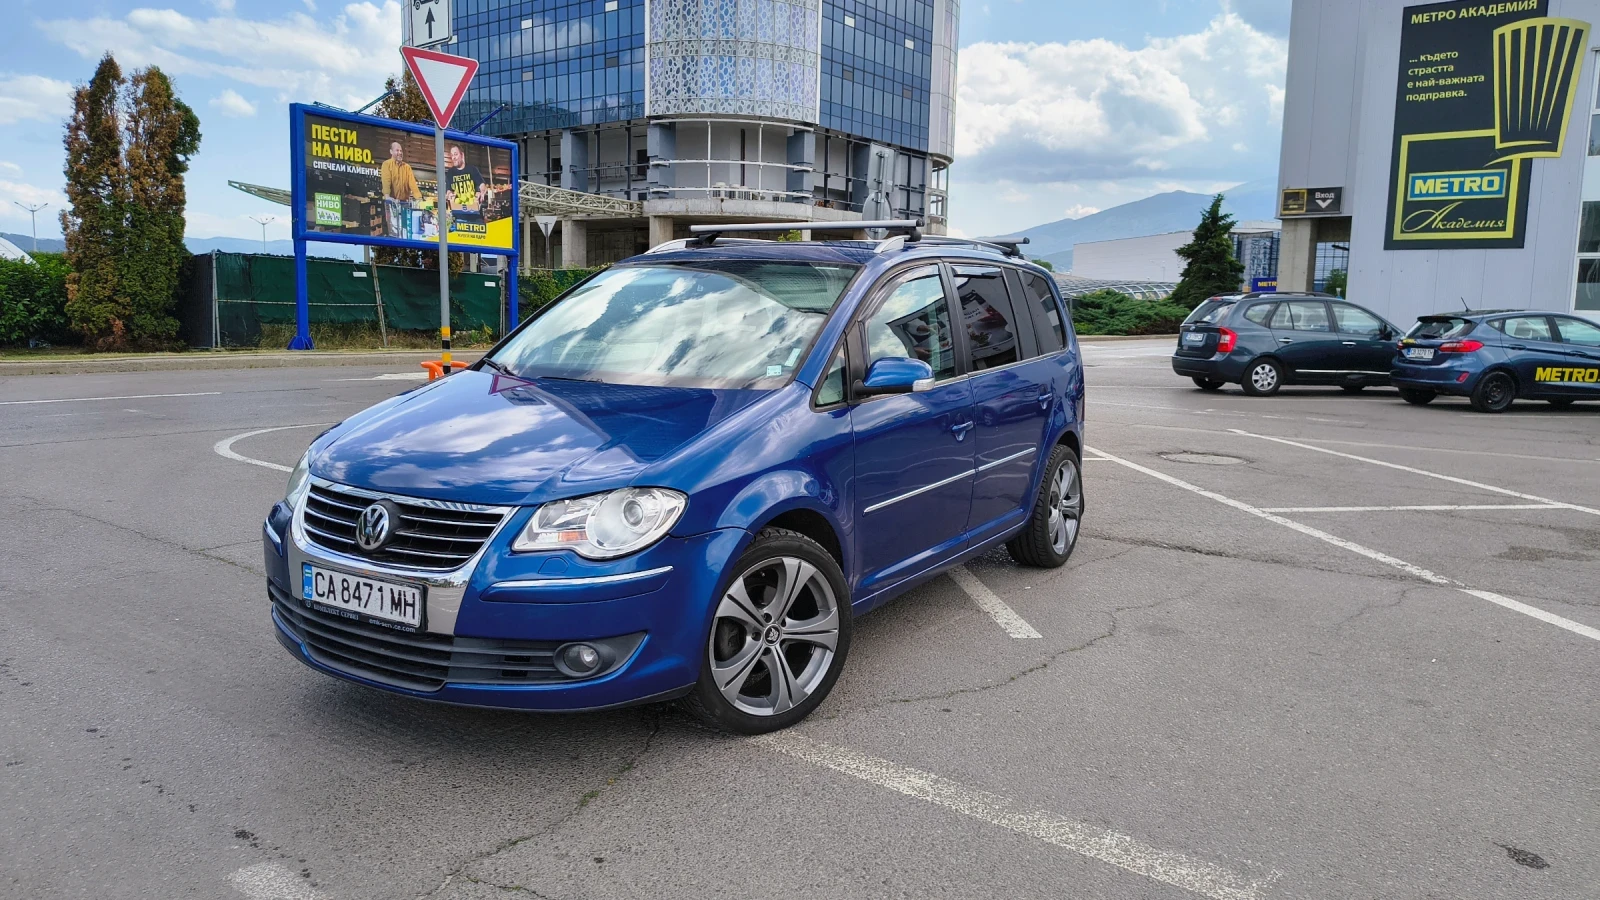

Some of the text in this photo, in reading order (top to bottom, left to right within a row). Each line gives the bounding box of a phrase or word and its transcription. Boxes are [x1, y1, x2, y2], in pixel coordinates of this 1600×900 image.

[1411, 0, 1538, 25] МЕТРО АКАДЕМИЯ
[1420, 51, 1459, 63] където
[1408, 64, 1454, 76] страстта
[1416, 74, 1485, 88] най-важната
[1406, 90, 1467, 102] подправка.
[311, 123, 357, 145] ПЕСТИ
[312, 141, 375, 164] НА НИВО.
[313, 161, 346, 172] СПЕЧЕЛИ
[452, 173, 471, 183] ПЕСТИ
[1414, 175, 1500, 194] METRO
[1315, 191, 1335, 199] Вход
[316, 200, 340, 209] НИВО
[1402, 201, 1504, 232] Академия
[456, 222, 486, 232] METRO
[341, 578, 384, 611] 8471
